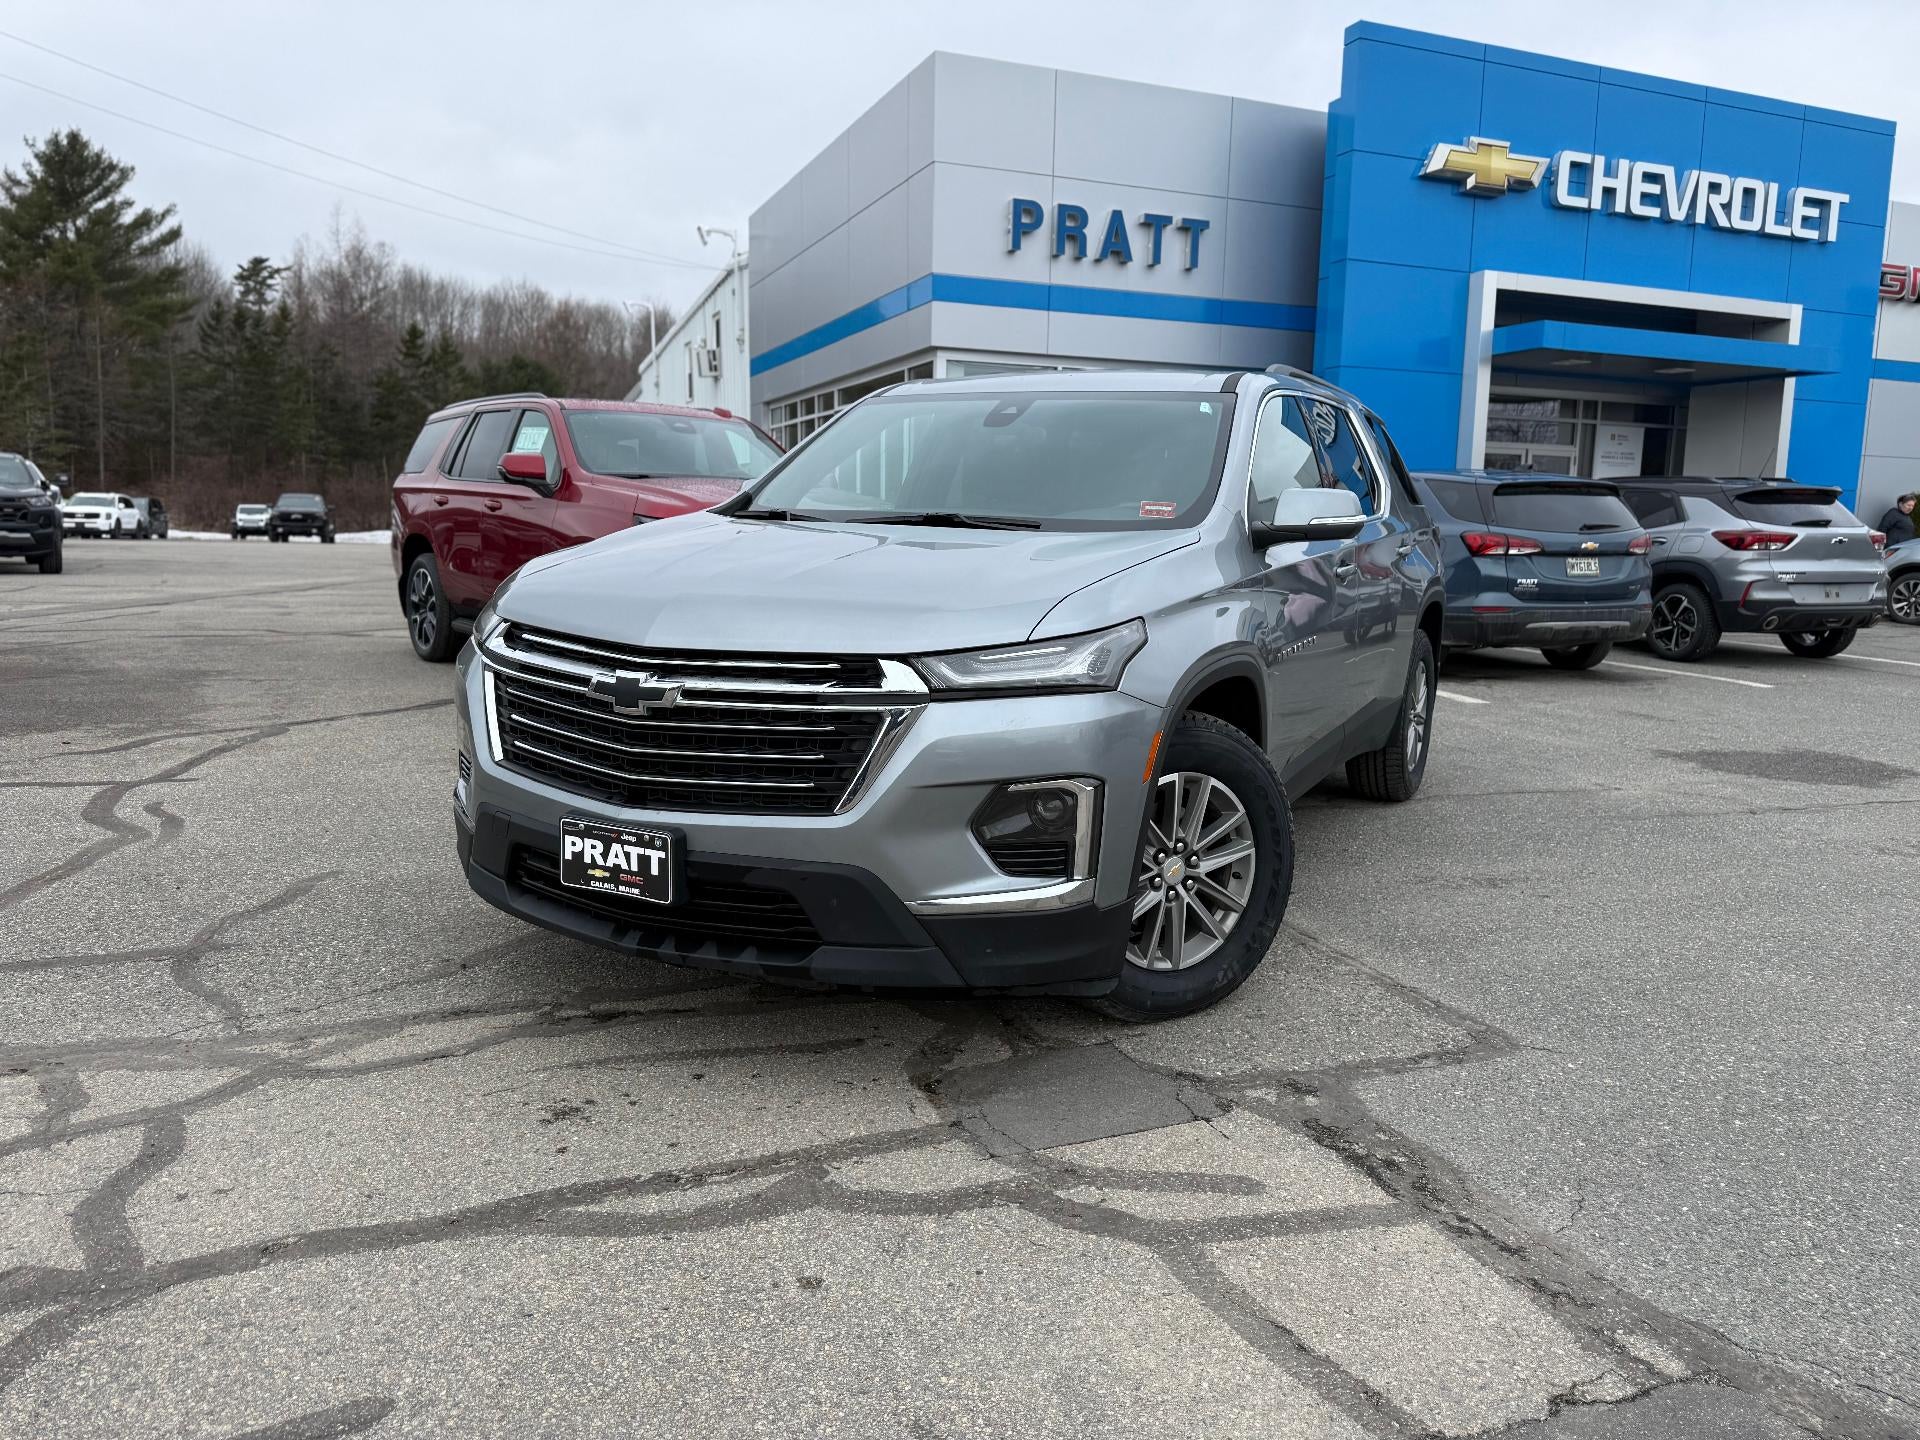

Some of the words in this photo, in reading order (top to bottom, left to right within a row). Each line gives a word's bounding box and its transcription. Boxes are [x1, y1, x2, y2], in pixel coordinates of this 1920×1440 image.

[1554, 150, 1850, 242] CHEVROLET
[1009, 198, 1210, 270] PRATT
[621, 833, 637, 842] Jeep
[564, 834, 666, 876] PRATT
[590, 880, 616, 891] CALAIS,
[618, 885, 641, 895] MAINE
[619, 873, 644, 885] GMC
